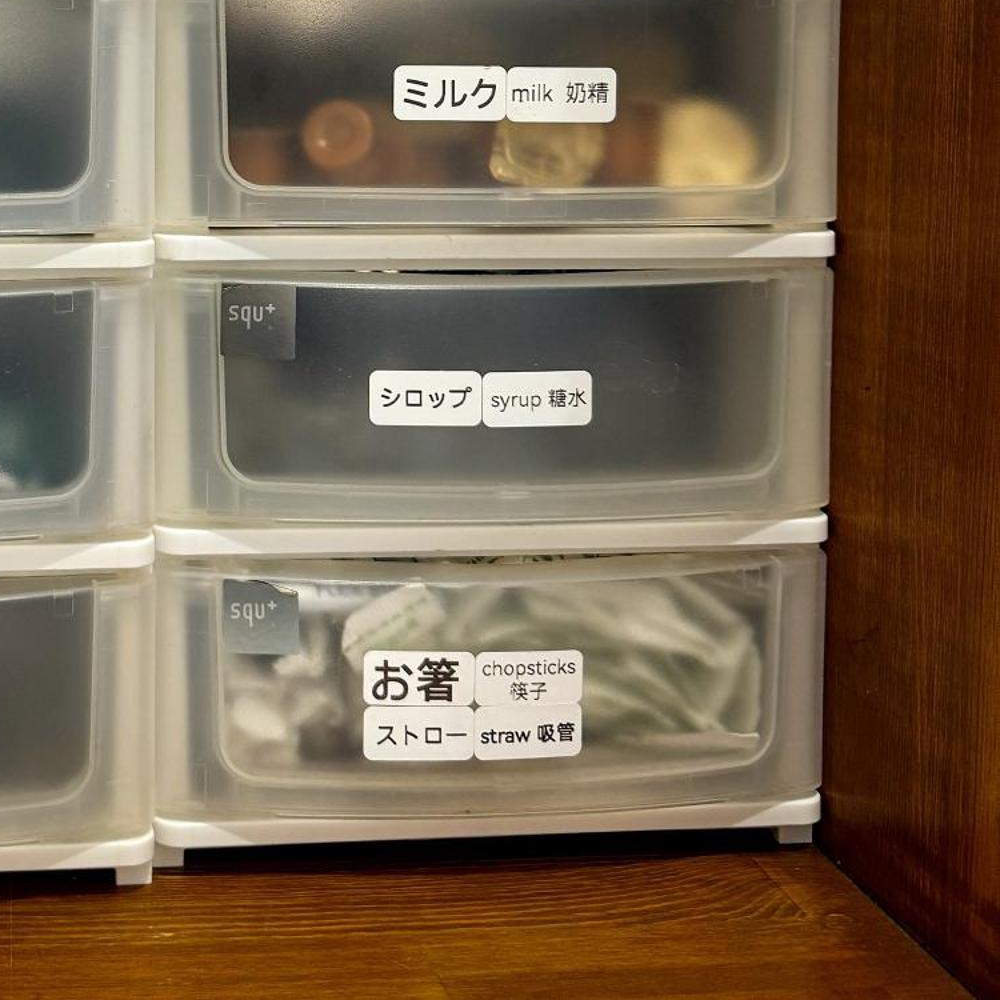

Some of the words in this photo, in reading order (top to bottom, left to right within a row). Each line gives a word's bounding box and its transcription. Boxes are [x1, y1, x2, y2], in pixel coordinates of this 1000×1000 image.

[403, 77, 497, 110] ミルク
[511, 83, 554, 104] milk
[565, 81, 610, 104] 奶精
[380, 385, 473, 409] シロップ
[490, 394, 543, 413] syrup
[547, 387, 588, 408] 糖水
[370, 656, 461, 704] お箸
[481, 658, 577, 680] chopsticks
[509, 681, 548, 701] 筷子
[376, 724, 468, 747] ストロー
[480, 728, 532, 745] straw
[536, 721, 576, 744] 吸管
